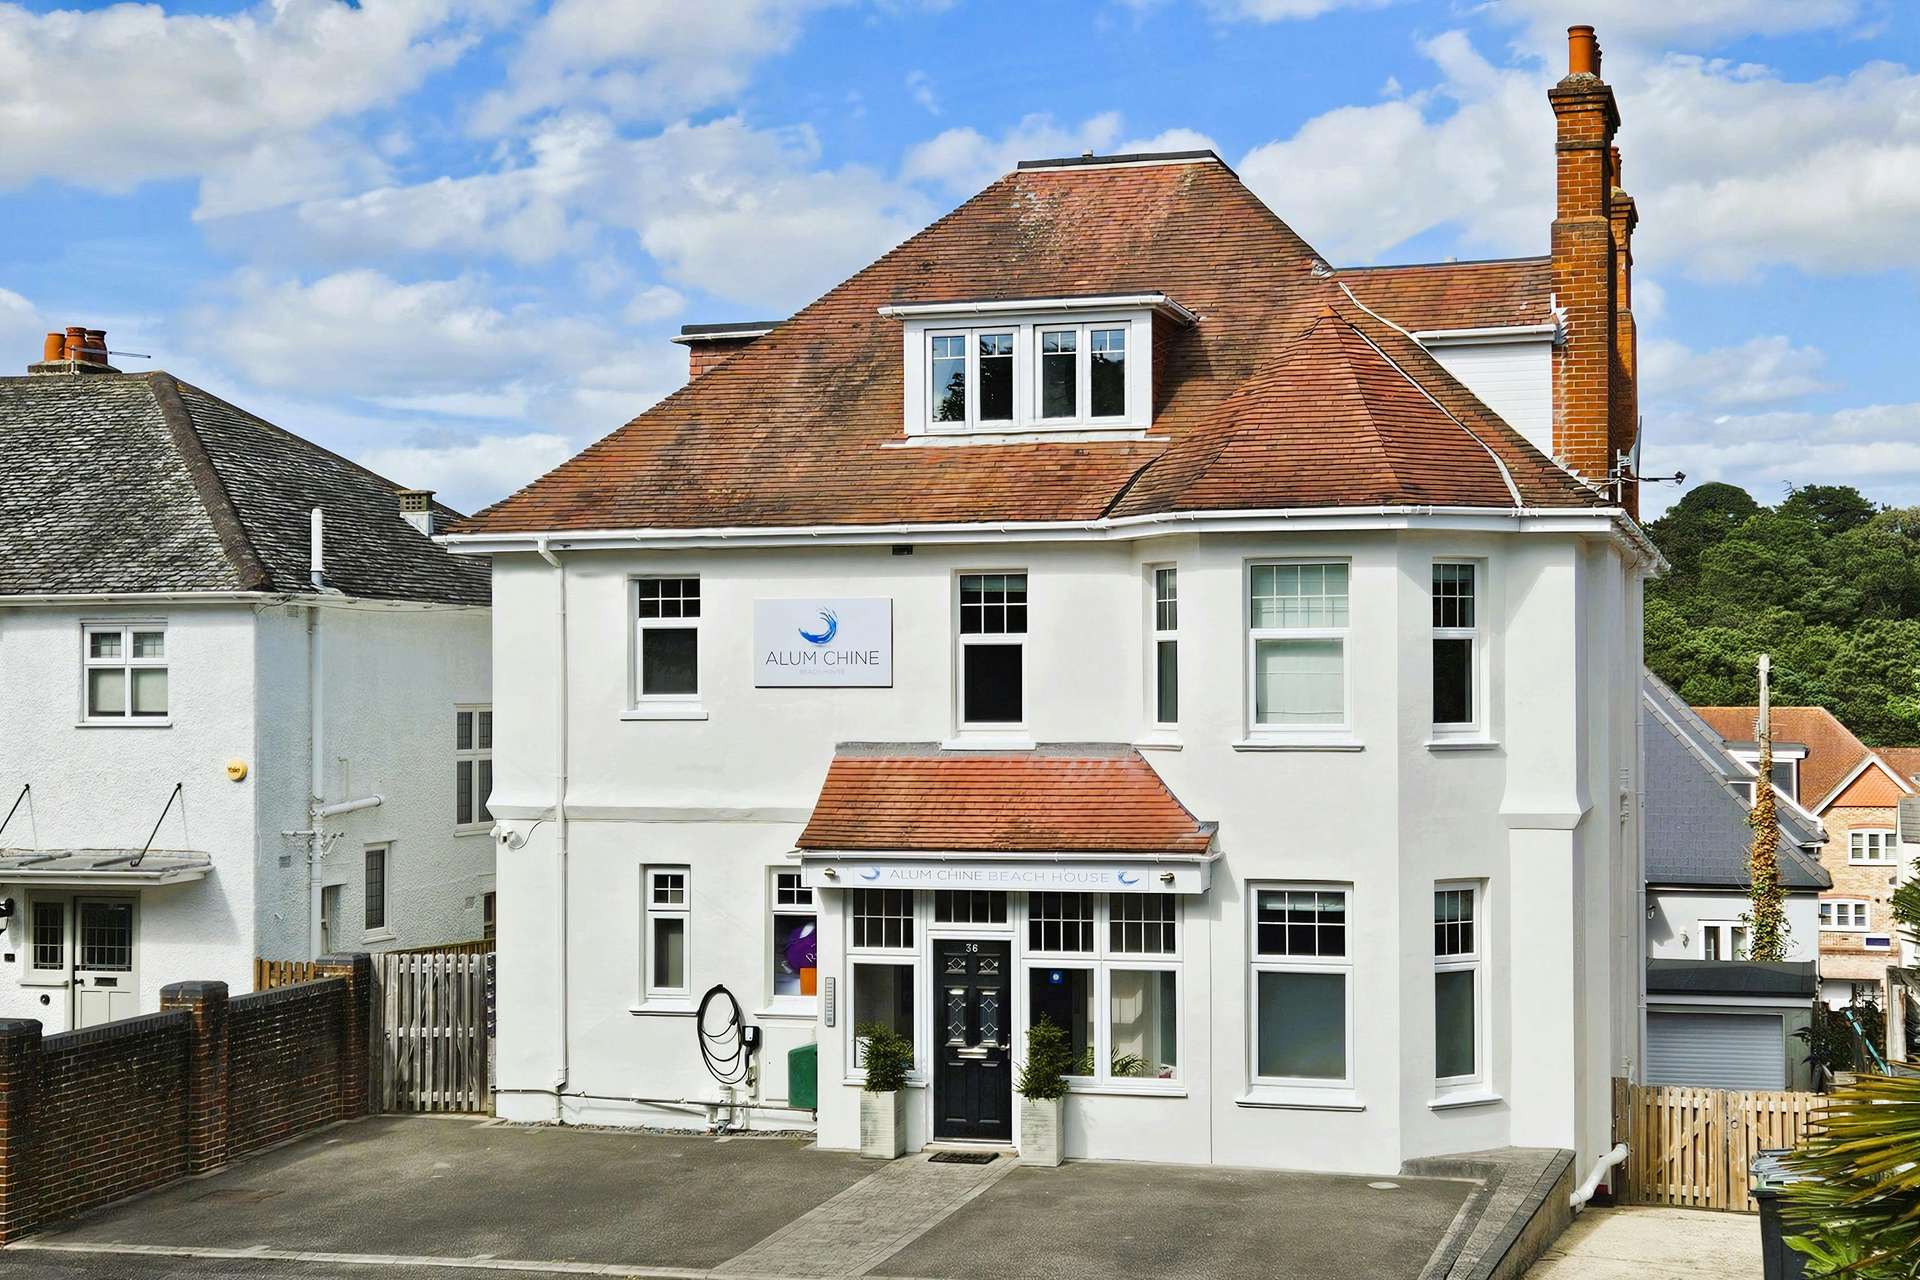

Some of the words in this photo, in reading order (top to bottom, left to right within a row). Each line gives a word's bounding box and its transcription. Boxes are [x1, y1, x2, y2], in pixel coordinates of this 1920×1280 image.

[765, 651, 817, 666] ALUM
[823, 650, 880, 666] CHINE
[889, 869, 932, 880] ALUM
[936, 870, 983, 881] CHINE
[988, 871, 1045, 881] BEACH
[1051, 872, 1110, 883] HOUSE
[965, 943, 978, 953] 36
